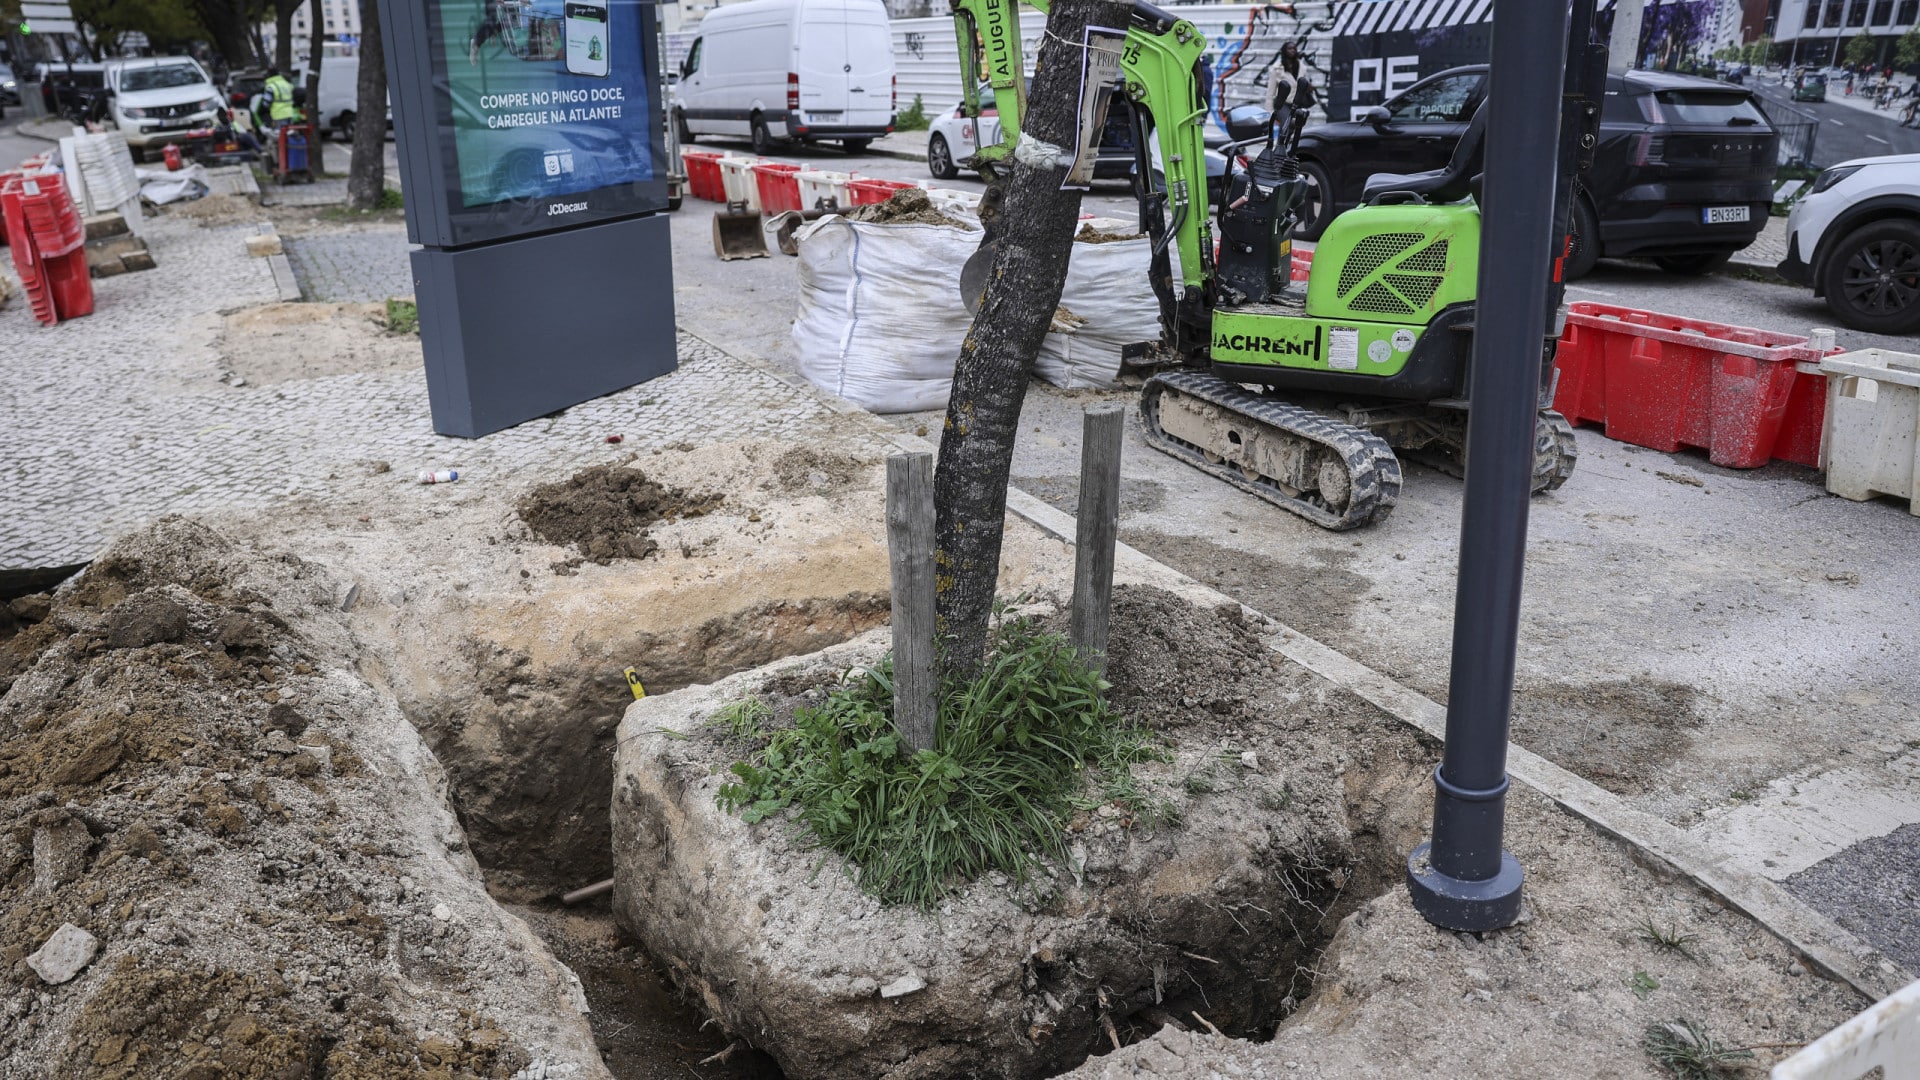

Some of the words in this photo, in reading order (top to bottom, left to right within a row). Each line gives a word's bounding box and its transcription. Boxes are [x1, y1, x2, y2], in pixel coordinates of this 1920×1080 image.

[1122, 46, 1141, 65] 15
[1351, 55, 1419, 100] PE
[480, 93, 529, 109] COMPRE
[532, 92, 549, 105] NO
[552, 89, 588, 104] PINGO
[591, 87, 625, 102] DOCE,
[487, 111, 548, 129] CARREGUE
[551, 109, 567, 123] NA
[569, 105, 621, 121] ATLANTE!
[547, 201, 588, 216] JCDecaux
[1711, 208, 1746, 222] BN33RT
